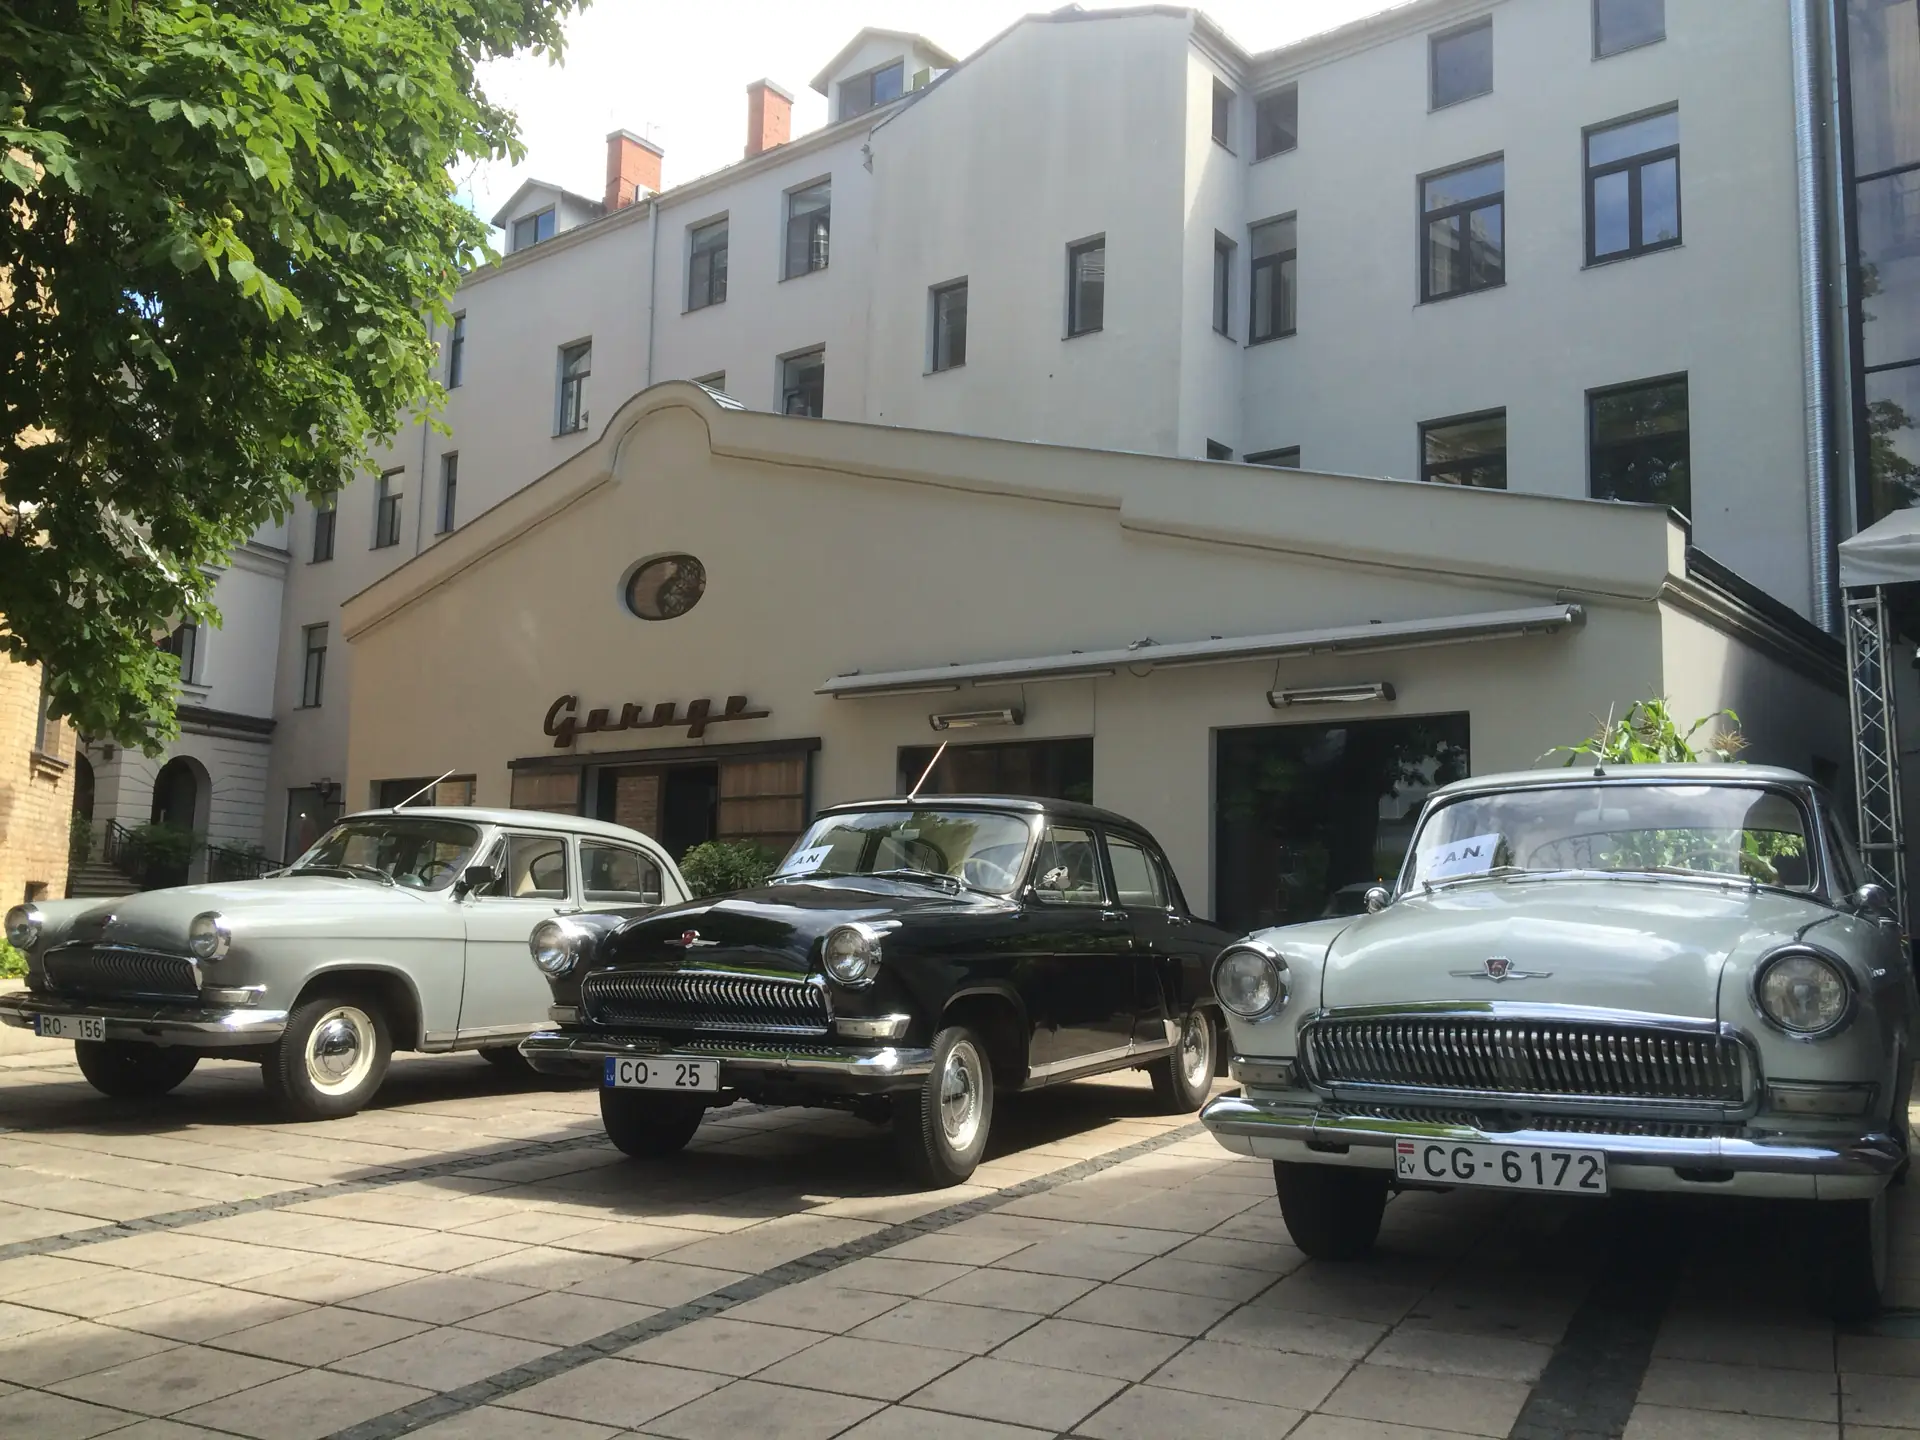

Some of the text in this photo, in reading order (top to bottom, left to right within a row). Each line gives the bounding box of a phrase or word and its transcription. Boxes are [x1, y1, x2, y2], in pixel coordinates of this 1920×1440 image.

[543, 694, 770, 748] Garage
[78, 1019, 101, 1039] 156
[675, 1063, 701, 1087] 25
[1423, 1145, 1600, 1189] CG-6172
